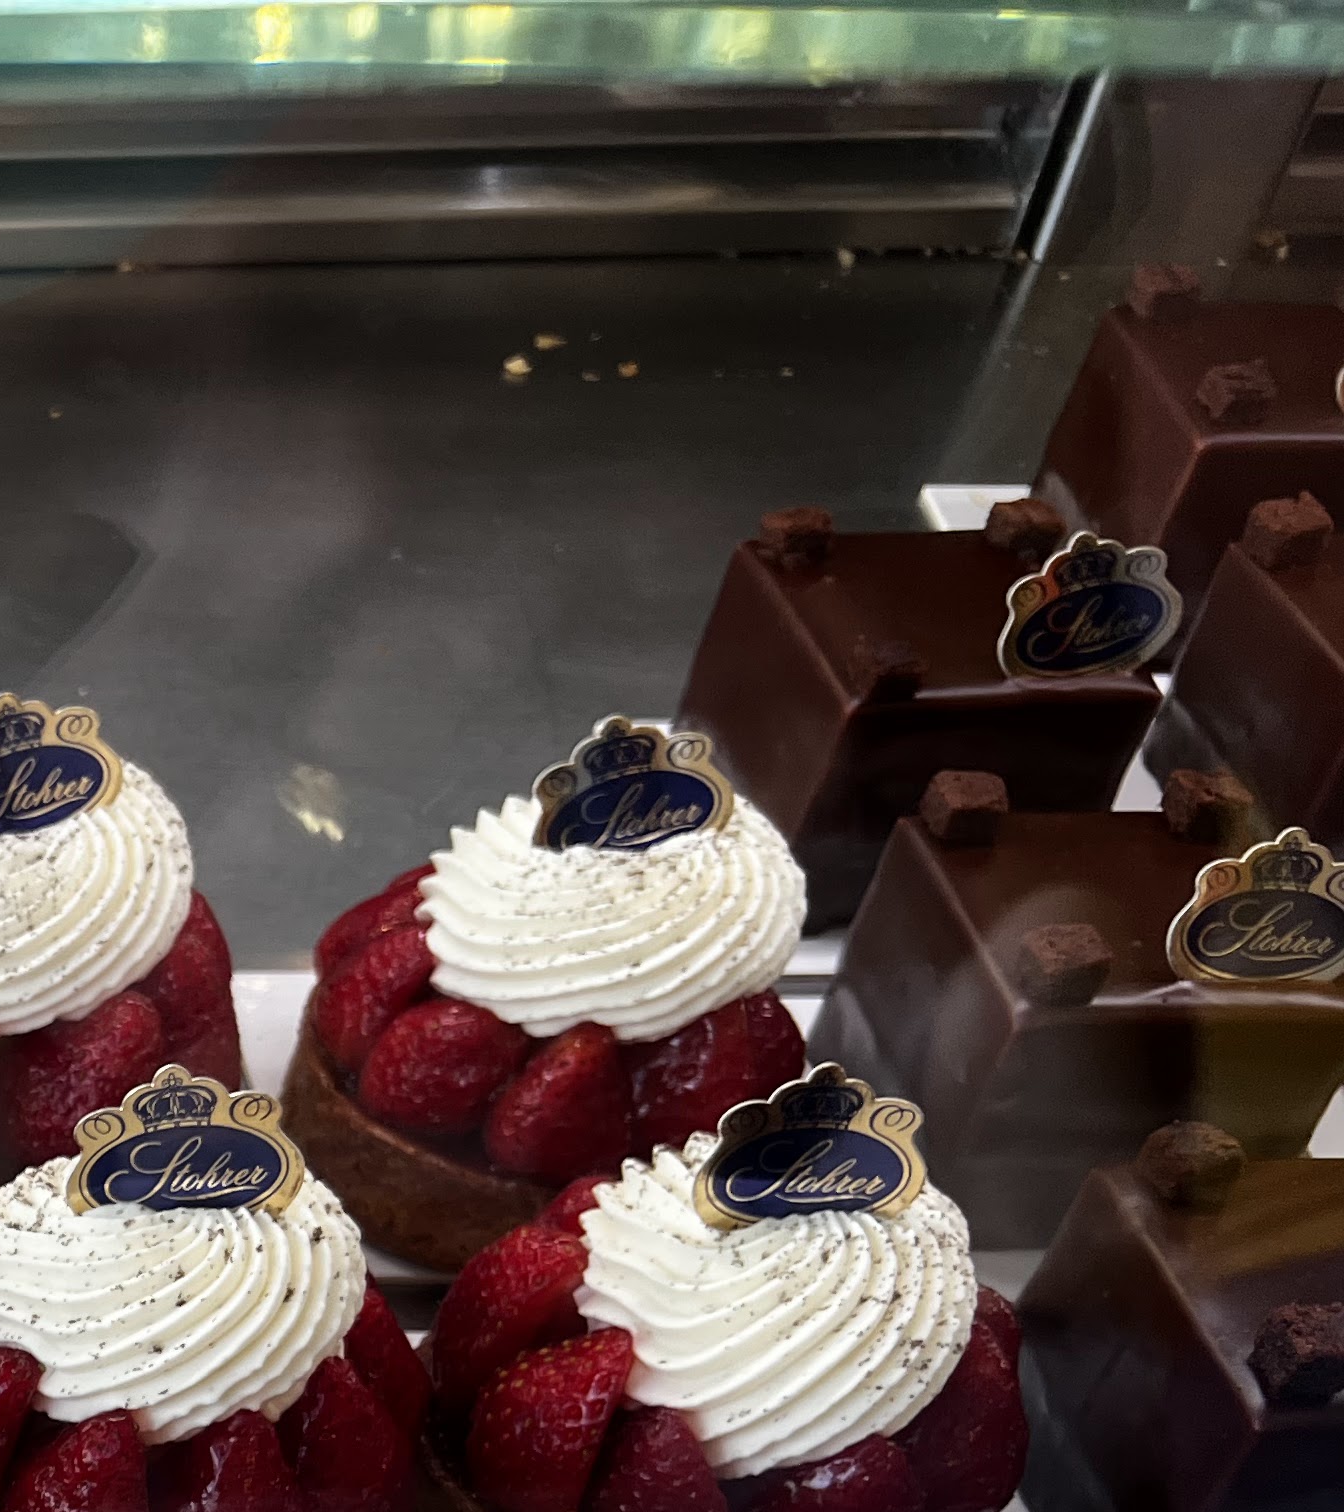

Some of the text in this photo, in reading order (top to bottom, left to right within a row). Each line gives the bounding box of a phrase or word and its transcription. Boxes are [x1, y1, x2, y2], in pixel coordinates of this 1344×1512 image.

[561, 783, 704, 849] Stohrer
[1198, 901, 1337, 958] Stohrer
[104, 1136, 268, 1204] Stohrer
[725, 1139, 887, 1203] Stohrer
